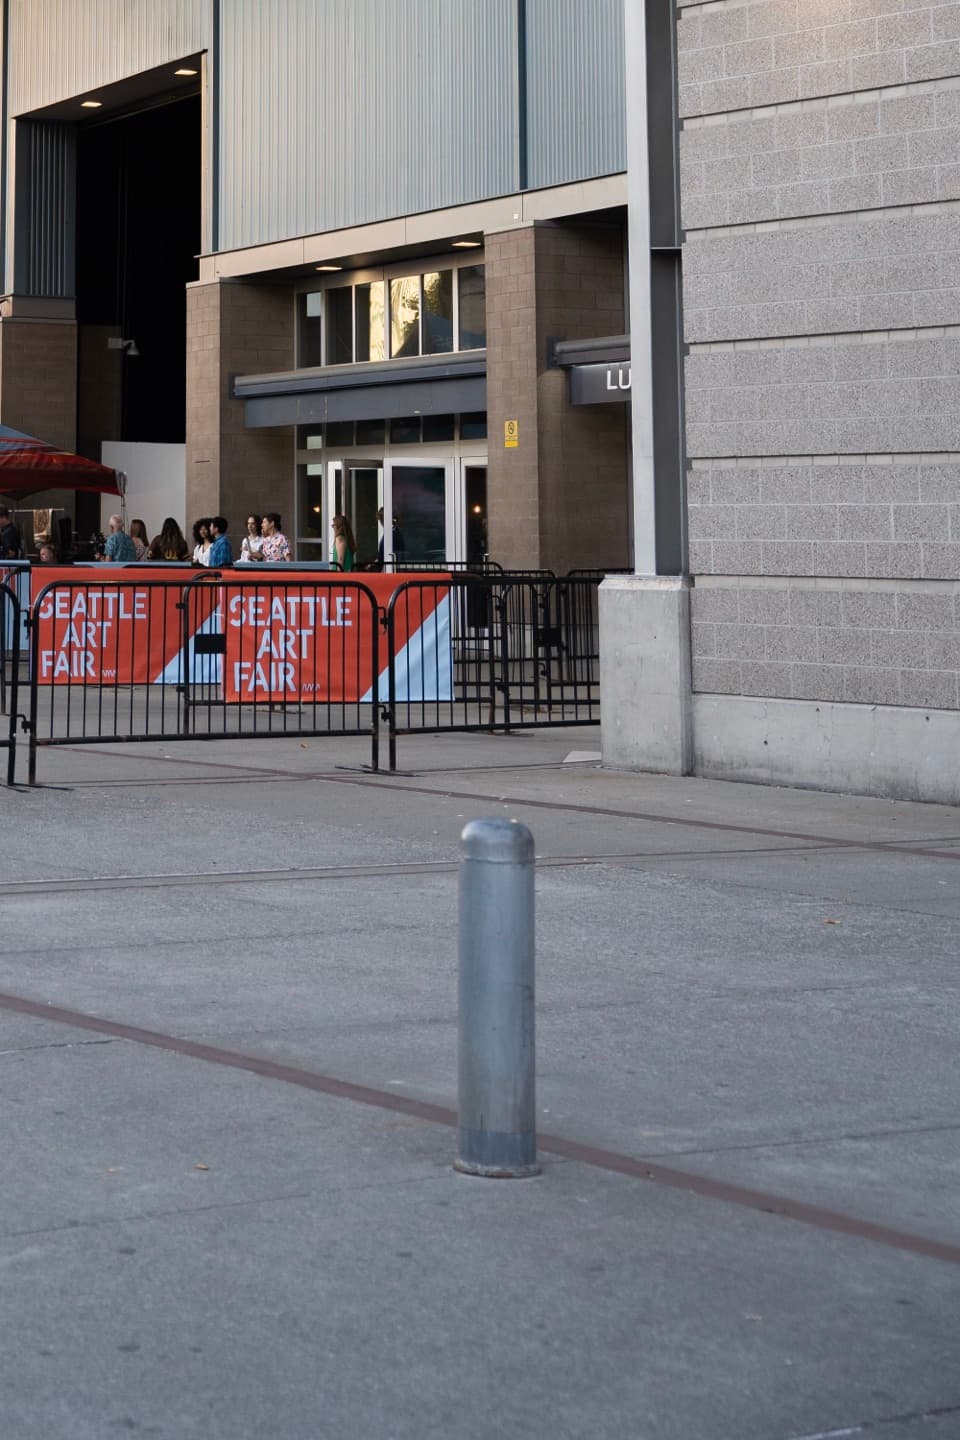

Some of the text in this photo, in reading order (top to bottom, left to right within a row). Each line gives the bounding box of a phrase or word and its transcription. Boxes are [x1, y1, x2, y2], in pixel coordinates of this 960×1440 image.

[38, 591, 147, 620] SEATTLE
[229, 596, 353, 627] SEATTLE
[61, 621, 112, 648] ART
[256, 629, 314, 659] ART
[41, 650, 96, 678] FAIR
[233, 662, 297, 692] FAIR
